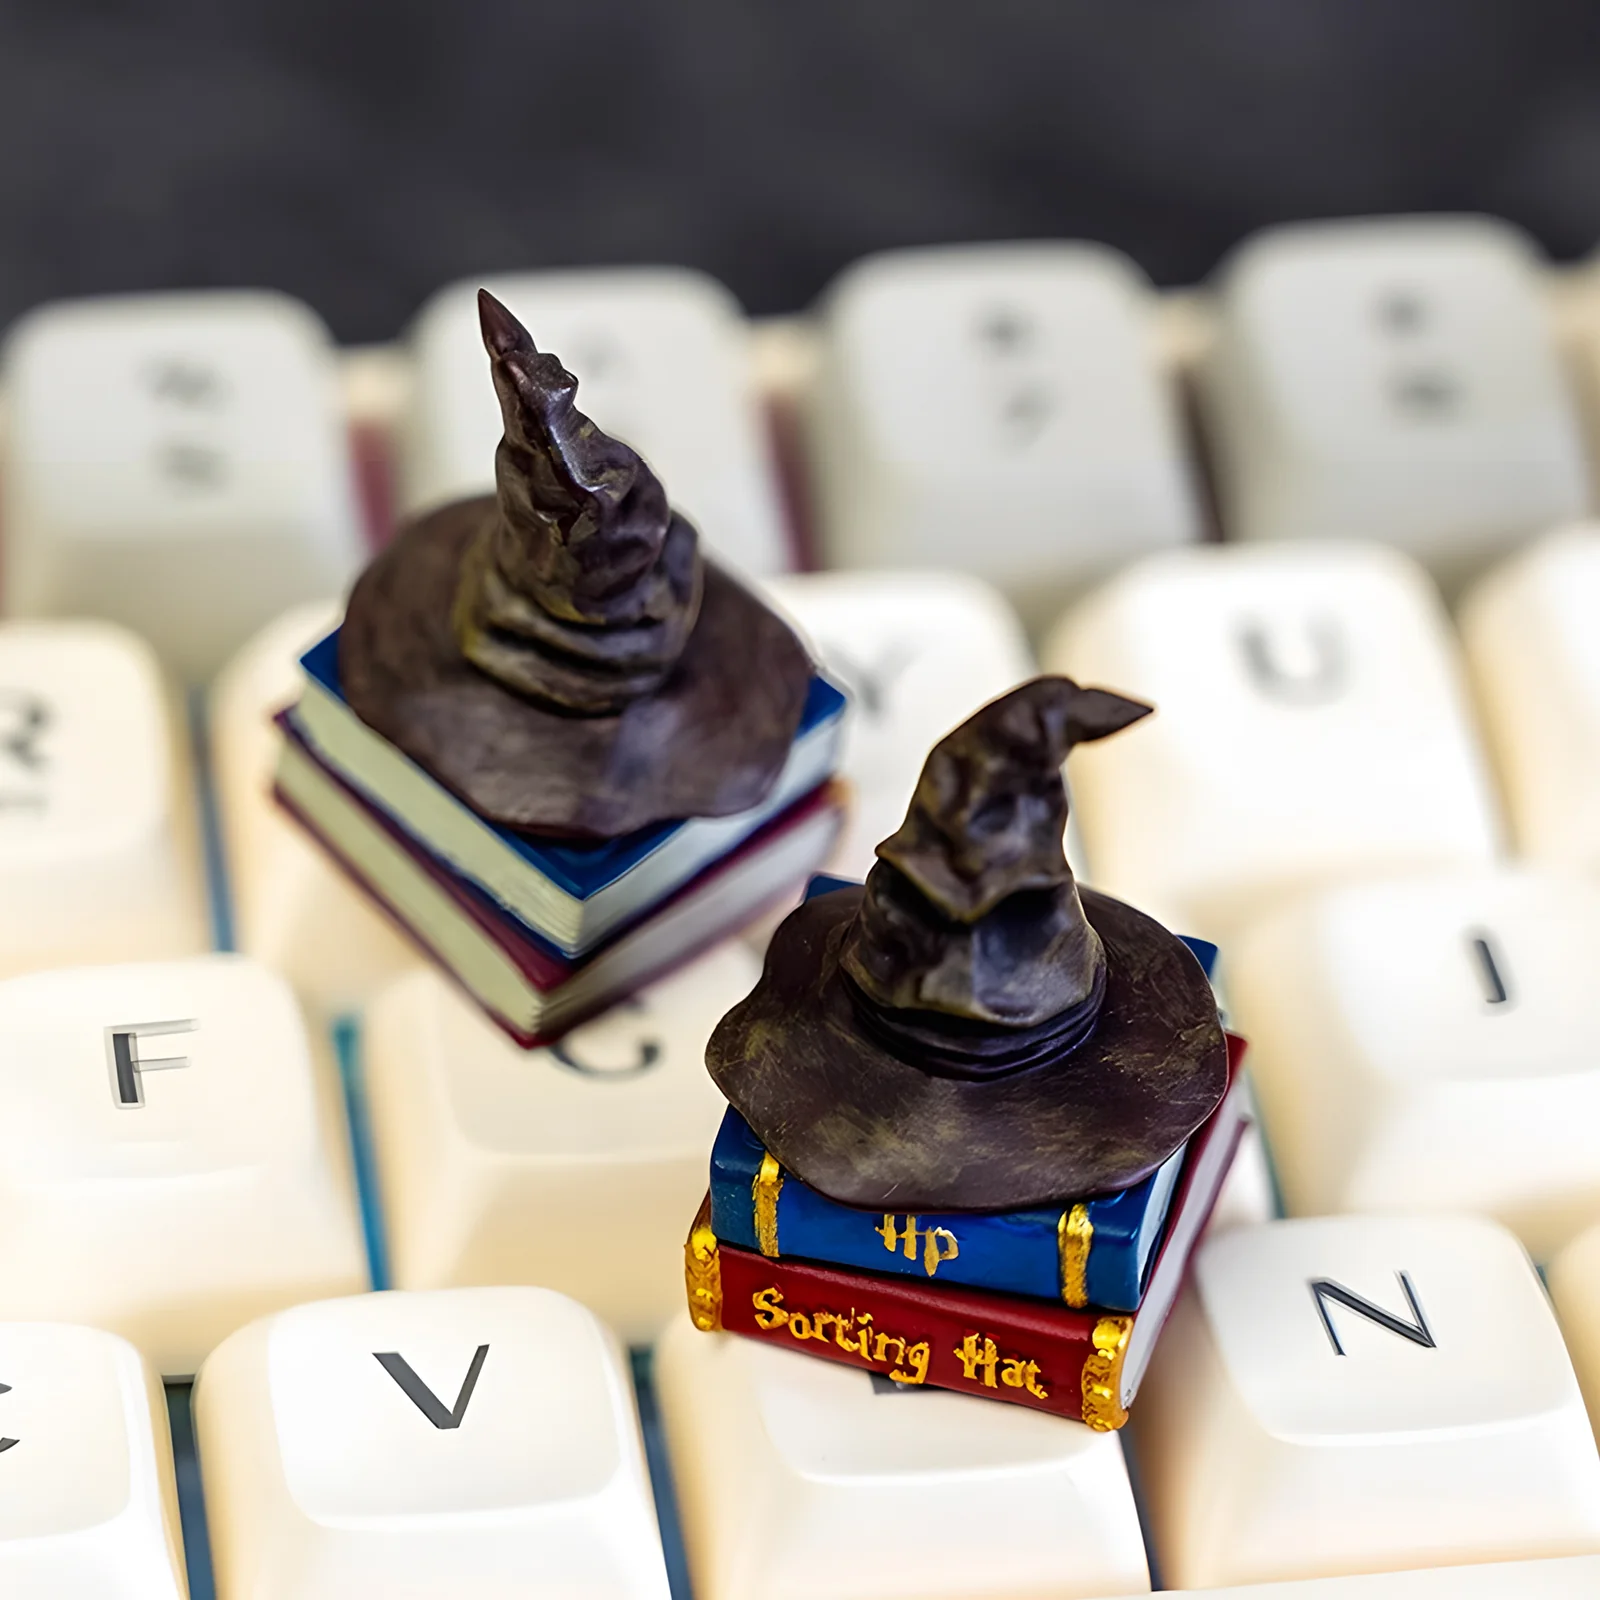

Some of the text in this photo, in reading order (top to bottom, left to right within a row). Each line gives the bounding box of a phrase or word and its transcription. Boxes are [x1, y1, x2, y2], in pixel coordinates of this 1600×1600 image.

[1230, 610, 1352, 706] U
[104, 1018, 200, 1110] F
[752, 1287, 1049, 1399] Sorting Hat
[1308, 1270, 1438, 1357] N
[372, 1344, 490, 1430] V
